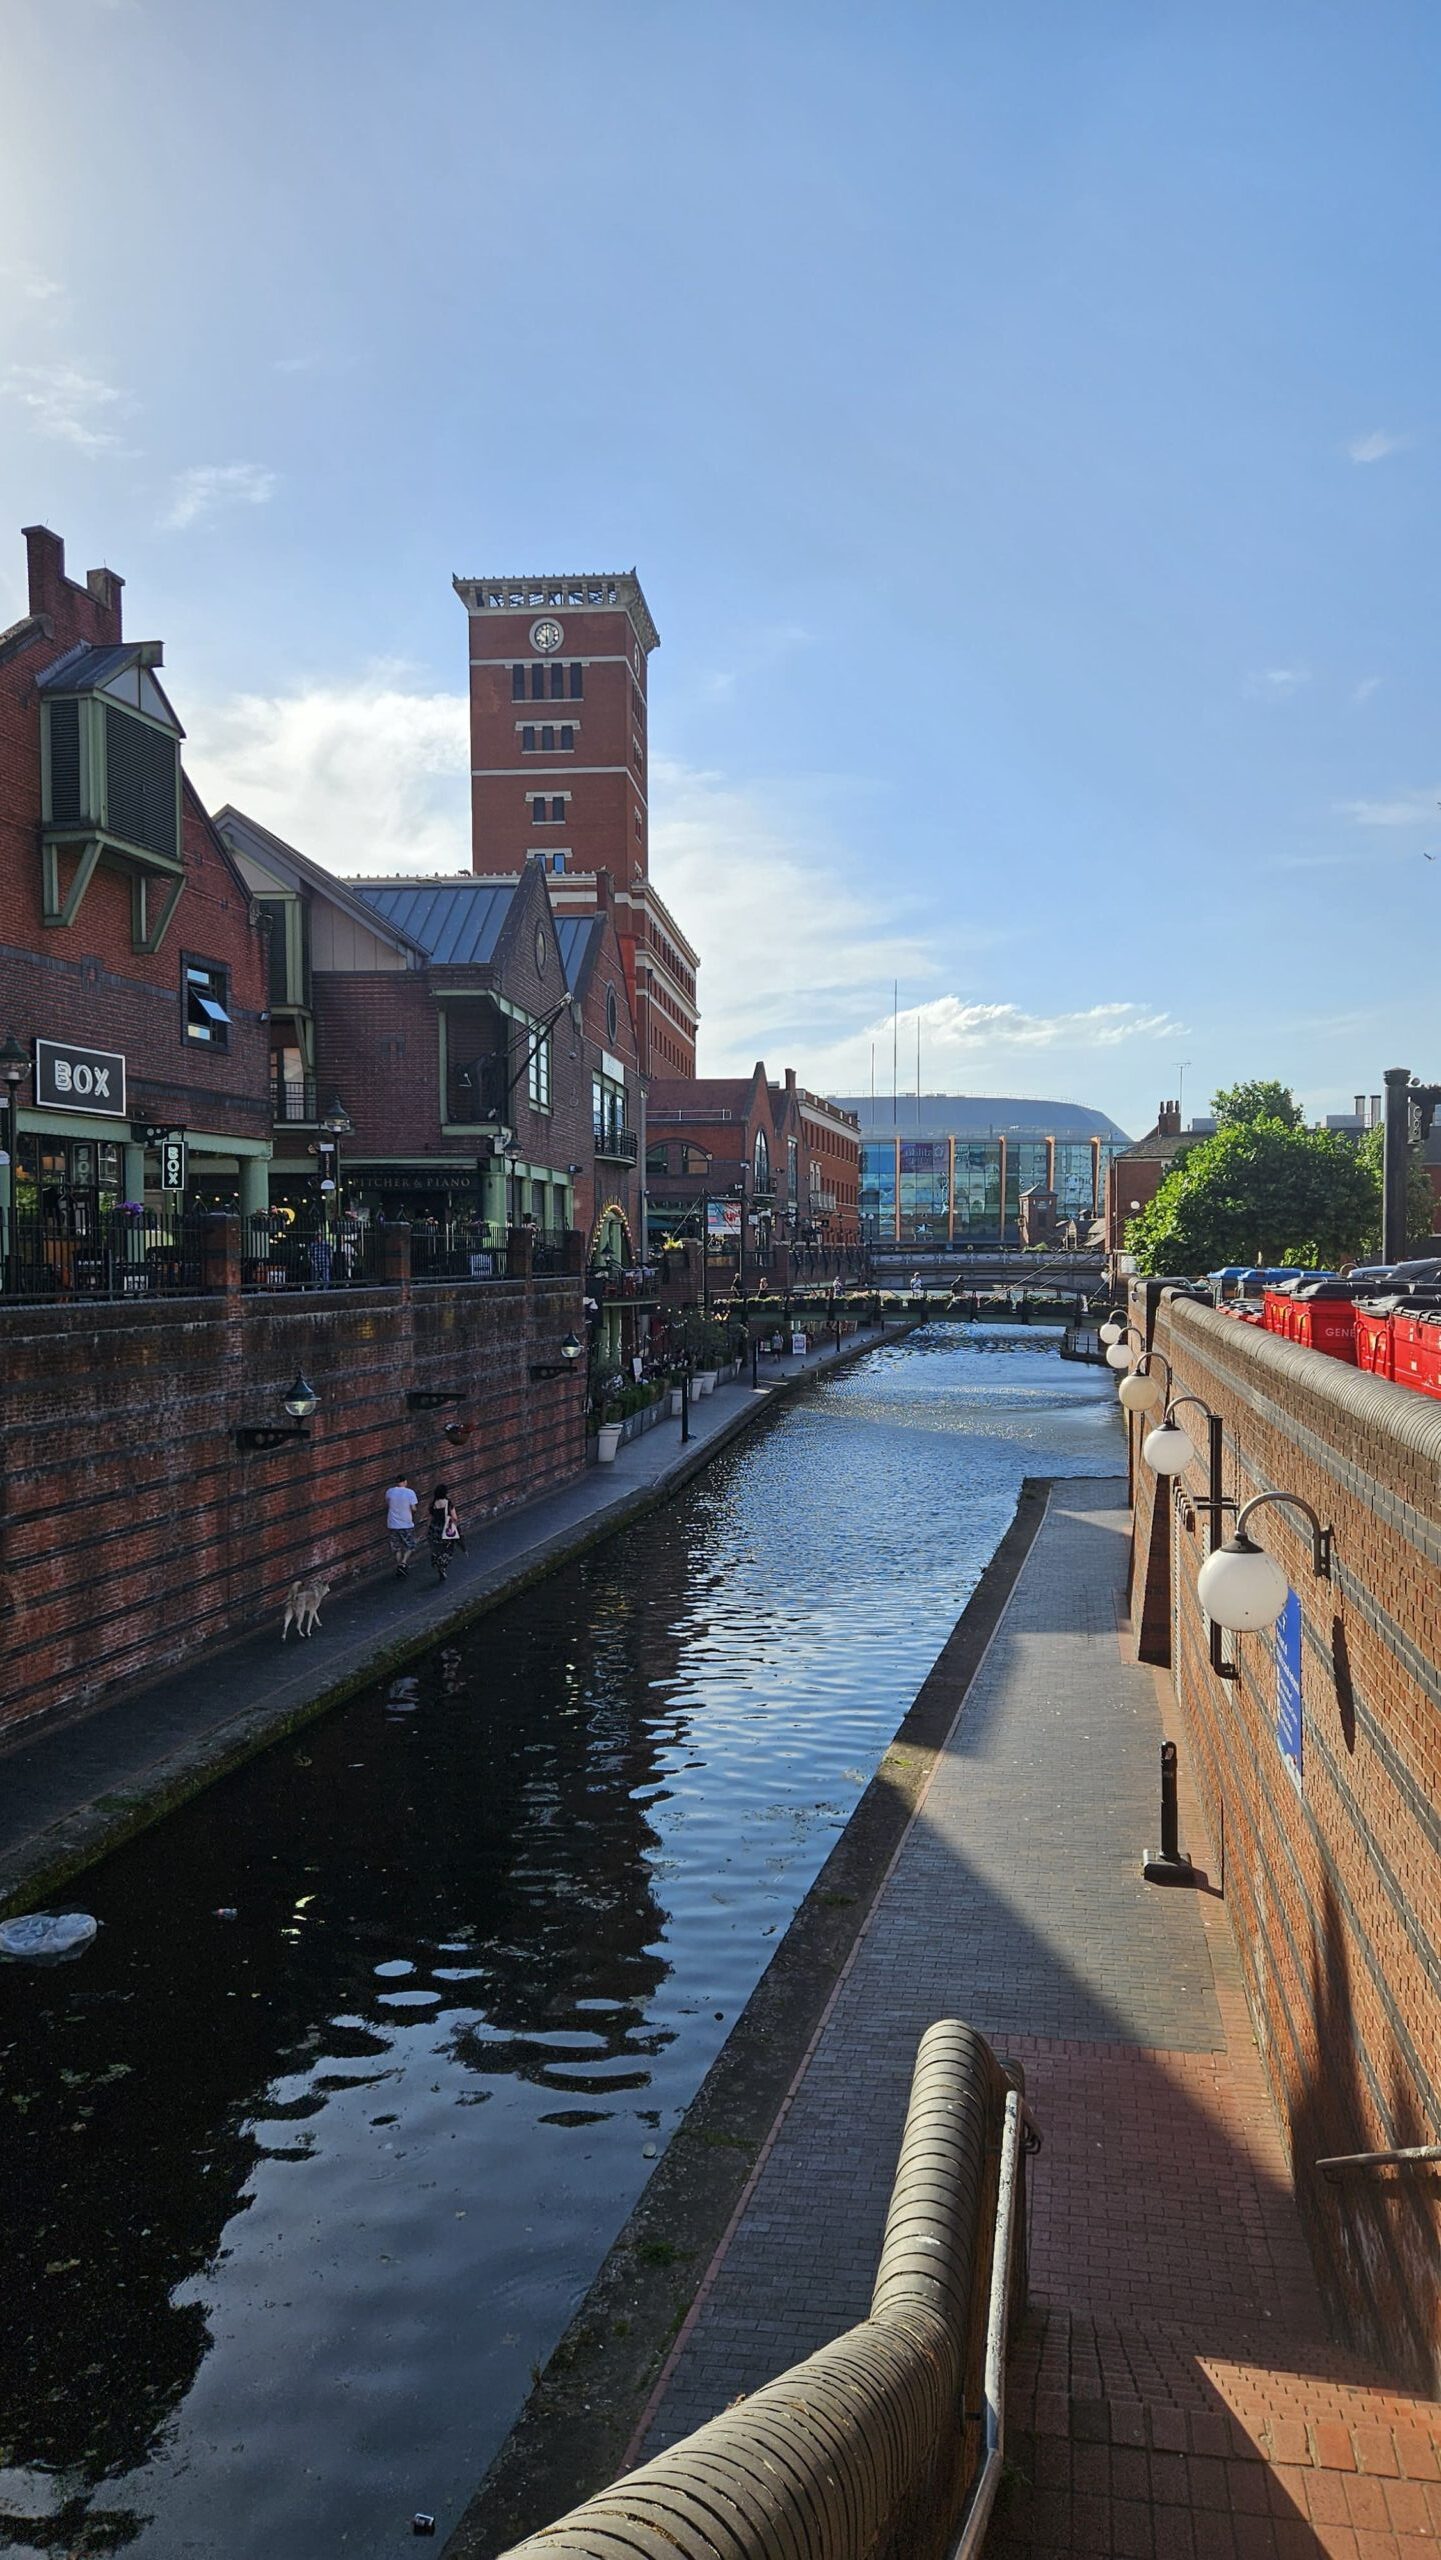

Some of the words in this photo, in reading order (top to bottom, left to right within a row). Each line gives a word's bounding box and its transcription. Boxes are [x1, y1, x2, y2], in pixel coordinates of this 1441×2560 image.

[54, 1059, 110, 1098] BOX
[167, 1146, 180, 1185] BOX
[352, 1177, 410, 1188] PITCHER
[427, 1177, 471, 1188] PIANO
